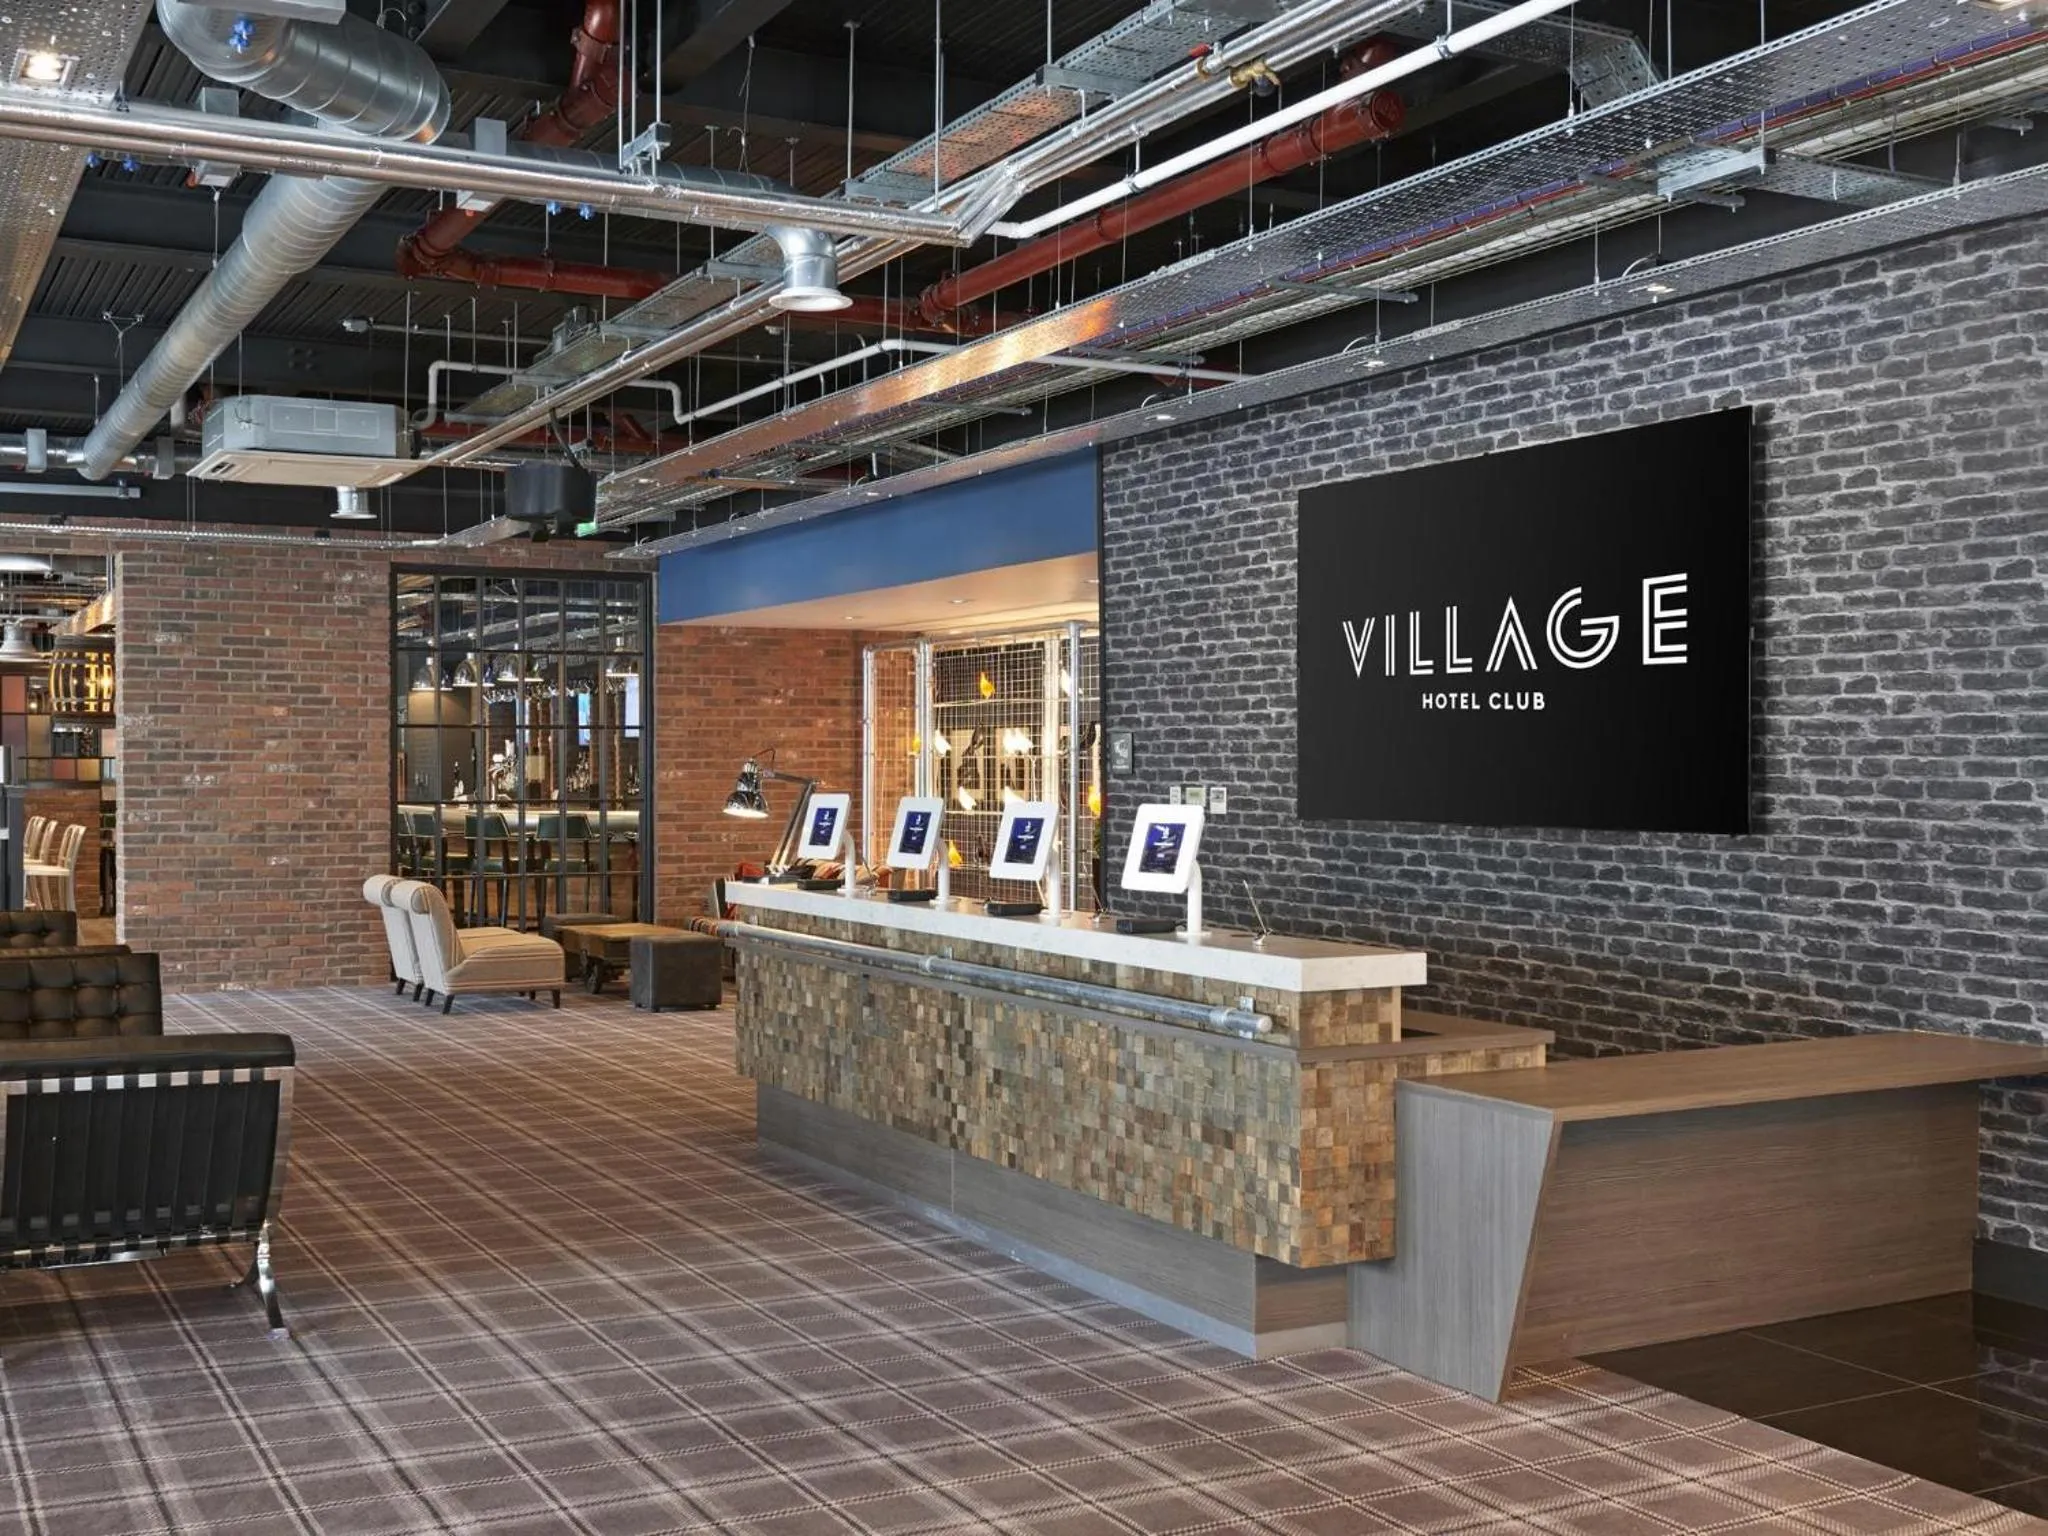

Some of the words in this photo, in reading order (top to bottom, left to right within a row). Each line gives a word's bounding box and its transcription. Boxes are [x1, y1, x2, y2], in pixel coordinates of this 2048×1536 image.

[1342, 573, 1688, 678] VILLAGE
[1422, 692, 1480, 710] HOTEL
[1488, 691, 1546, 711] CLUB
